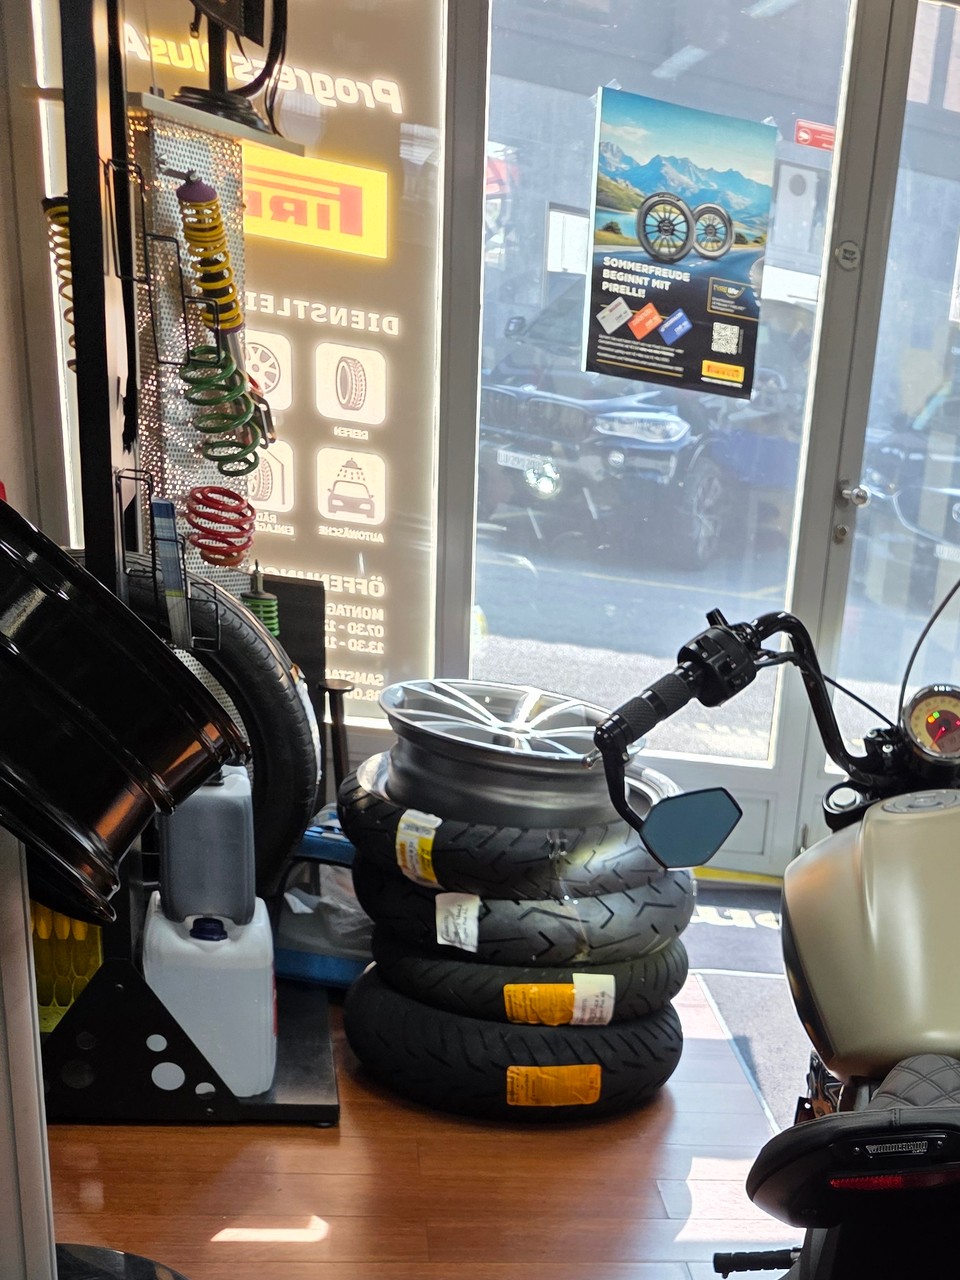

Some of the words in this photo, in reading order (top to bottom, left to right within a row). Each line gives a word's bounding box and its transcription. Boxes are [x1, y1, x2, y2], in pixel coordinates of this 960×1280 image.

[602, 256, 691, 283] SOMMERFREUDE
[602, 269, 649, 287] BEGINNT
[651, 278, 672, 292] MIT
